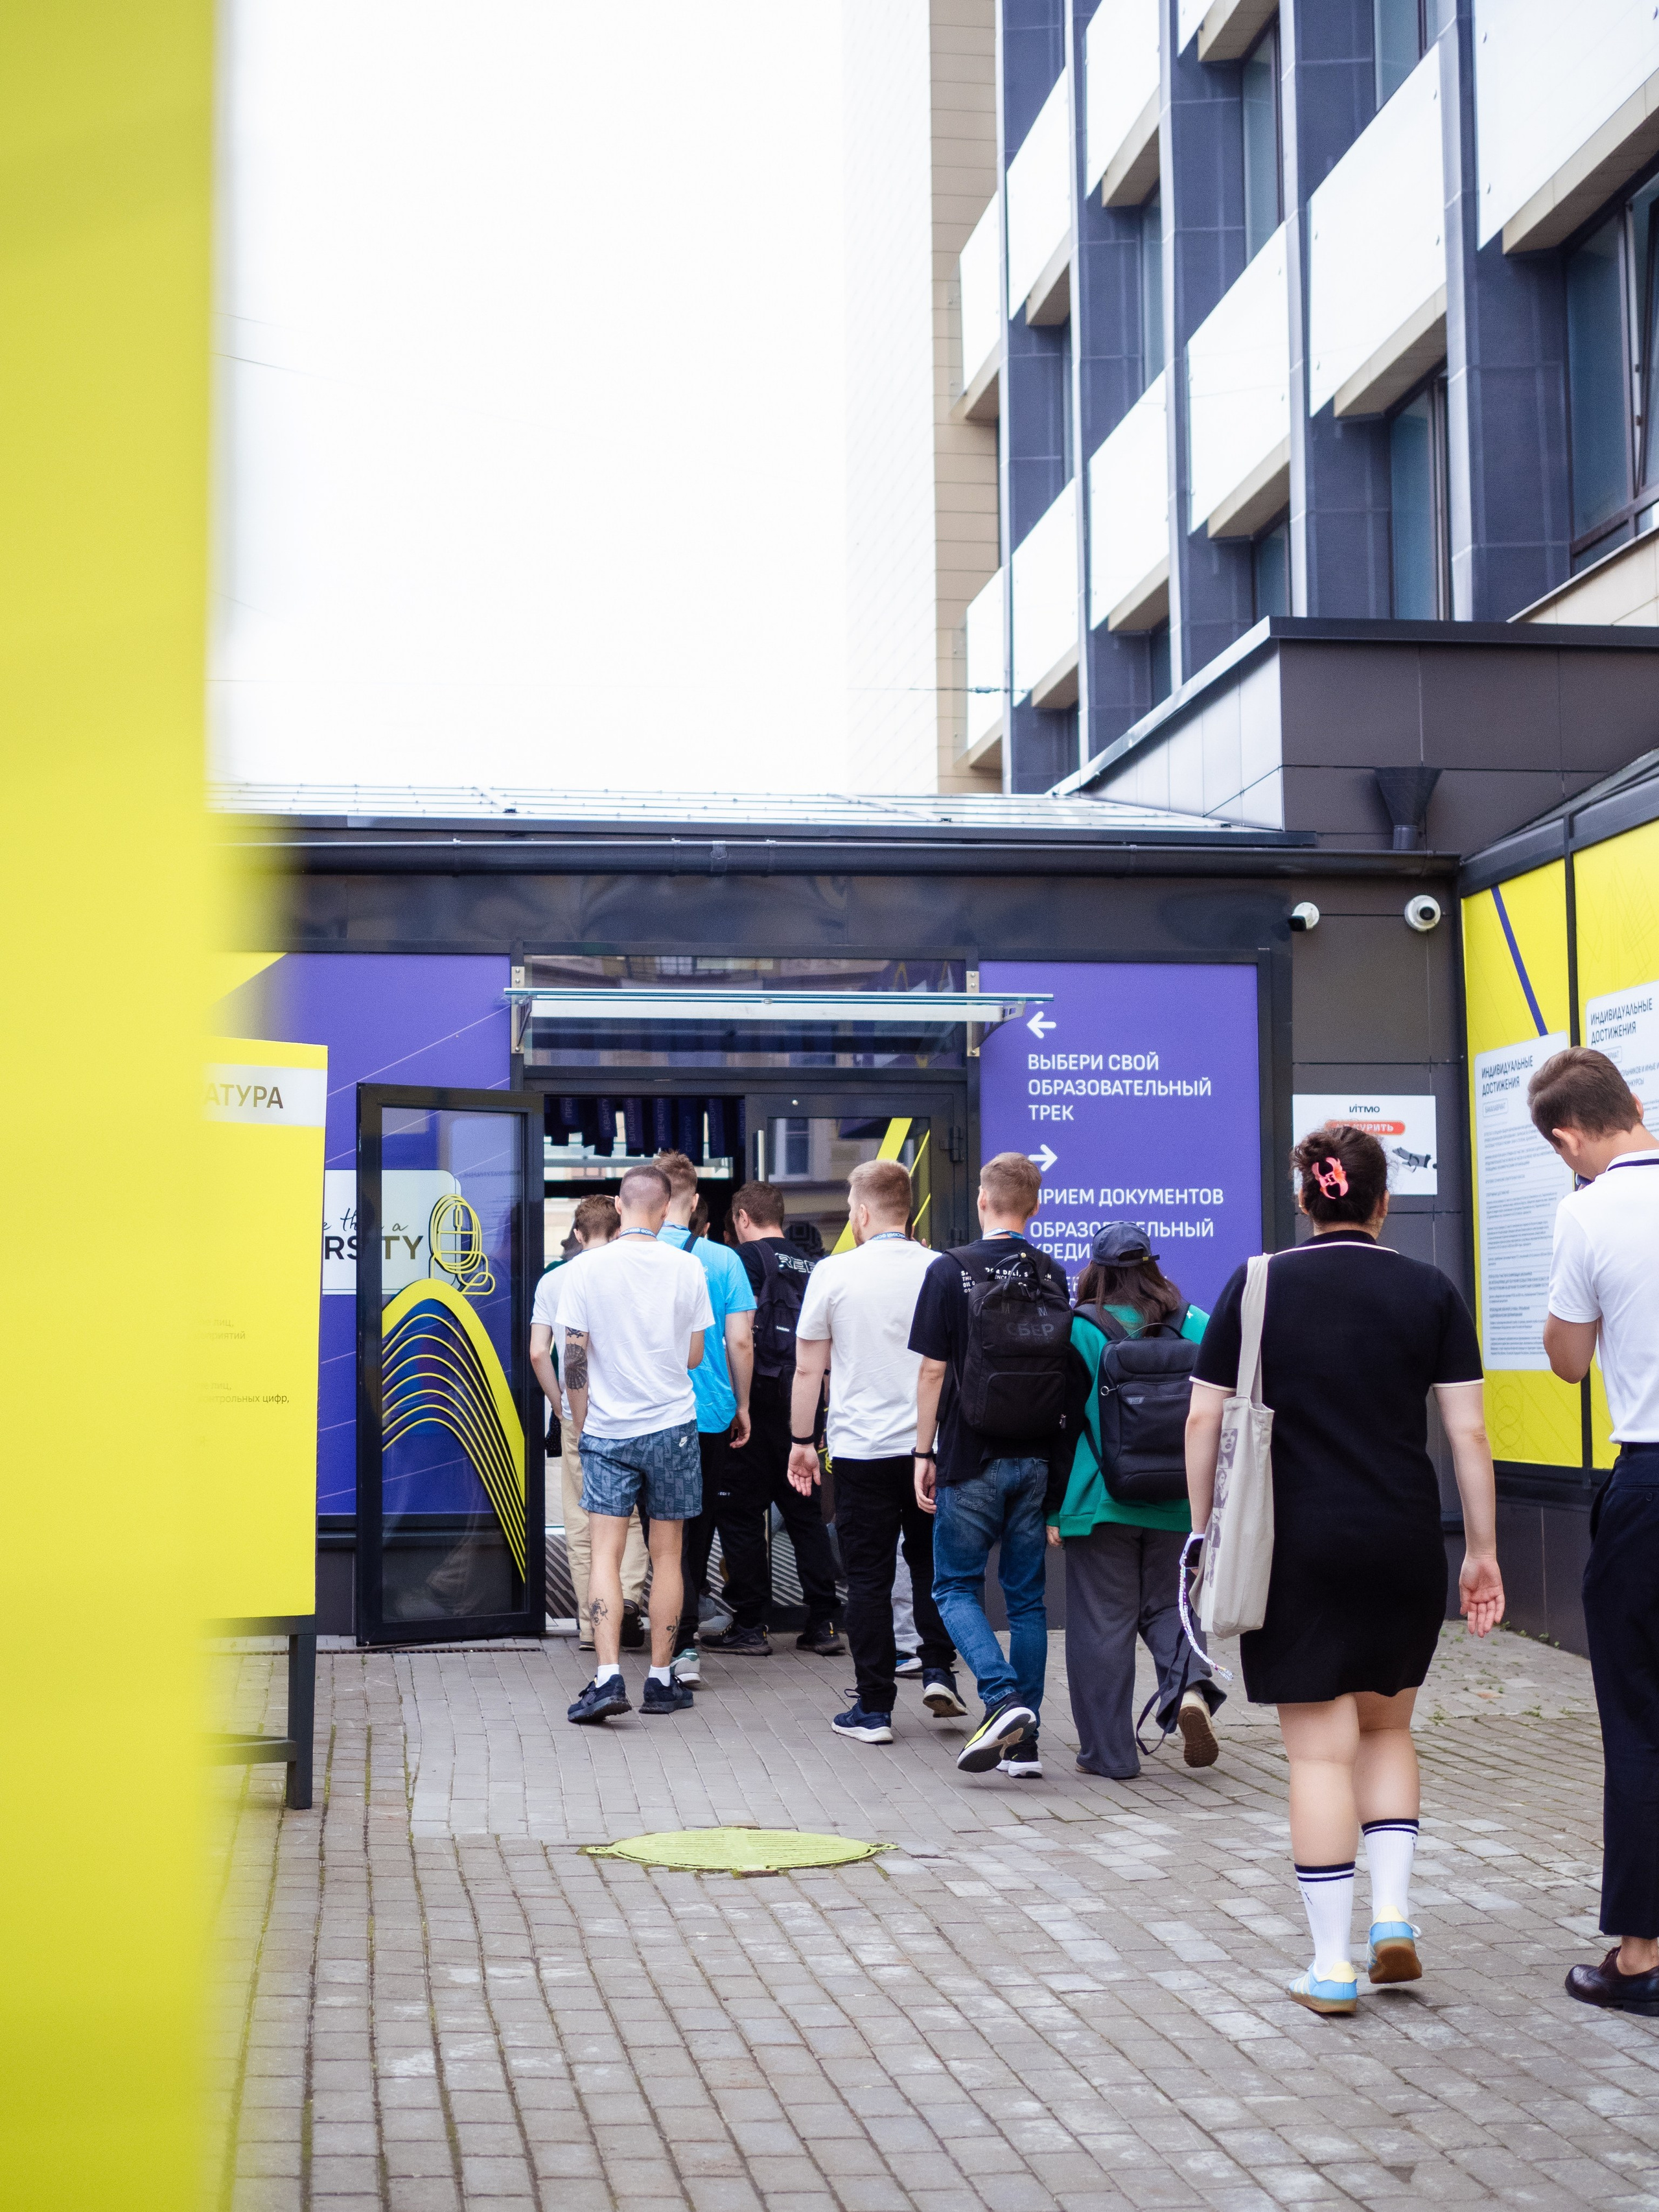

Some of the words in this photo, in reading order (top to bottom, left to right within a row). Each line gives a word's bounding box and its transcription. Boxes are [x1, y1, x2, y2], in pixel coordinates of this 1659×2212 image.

[1590, 998, 1653, 1026] ИНДИВИДУАЛЬНЫЕ
[1591, 1021, 1636, 1045] ДОСТИЖЕНИЯ
[1028, 1054, 1103, 1070] ВЫБЕРИ
[1108, 1051, 1159, 1071] СВОЙ
[1481, 1055, 1533, 1079] ИНДИВИДУАЛЬНЫЕ
[1028, 1077, 1212, 1096] ОБРАЗОВАТЕЛЬНЫЙ
[1482, 1076, 1520, 1097] ДОСТИЖЕНИЯ
[1028, 1105, 1074, 1121] ТРЕК
[1099, 1188, 1224, 1207] ДОКУМЕНТОВ
[325, 1235, 424, 1260] RSTY
[262, 1394, 289, 1404] цифр,
